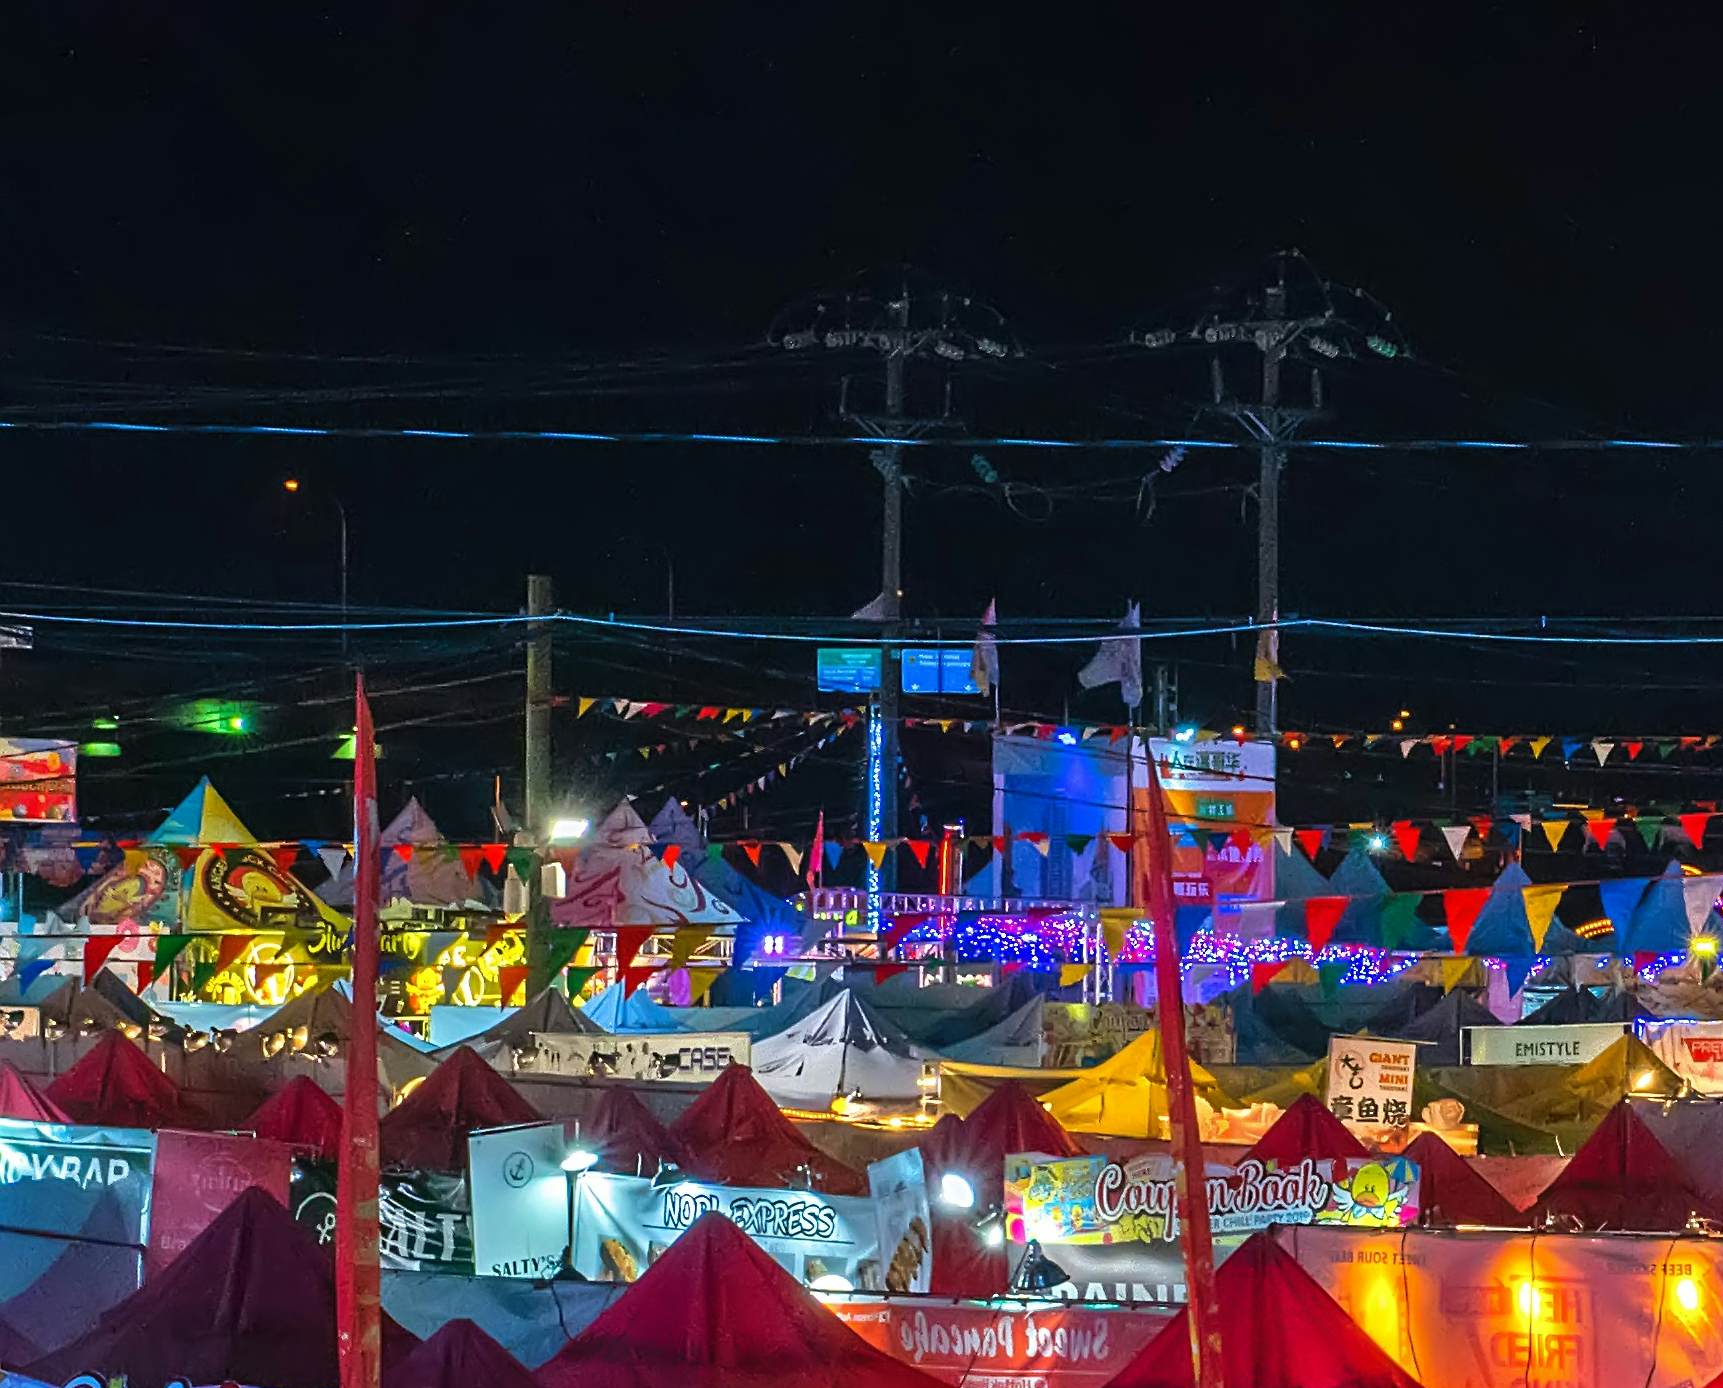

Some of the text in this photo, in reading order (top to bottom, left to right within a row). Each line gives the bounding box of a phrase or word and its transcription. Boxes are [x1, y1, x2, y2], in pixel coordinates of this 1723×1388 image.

[678, 1047, 731, 1071] CASE
[1368, 1051, 1411, 1067] GIANT
[1515, 1041, 1580, 1057] EMISTYLE
[1378, 1073, 1409, 1085] MINI
[1232, 1159, 1328, 1215] Book
[729, 1196, 836, 1238] EXPRESS
